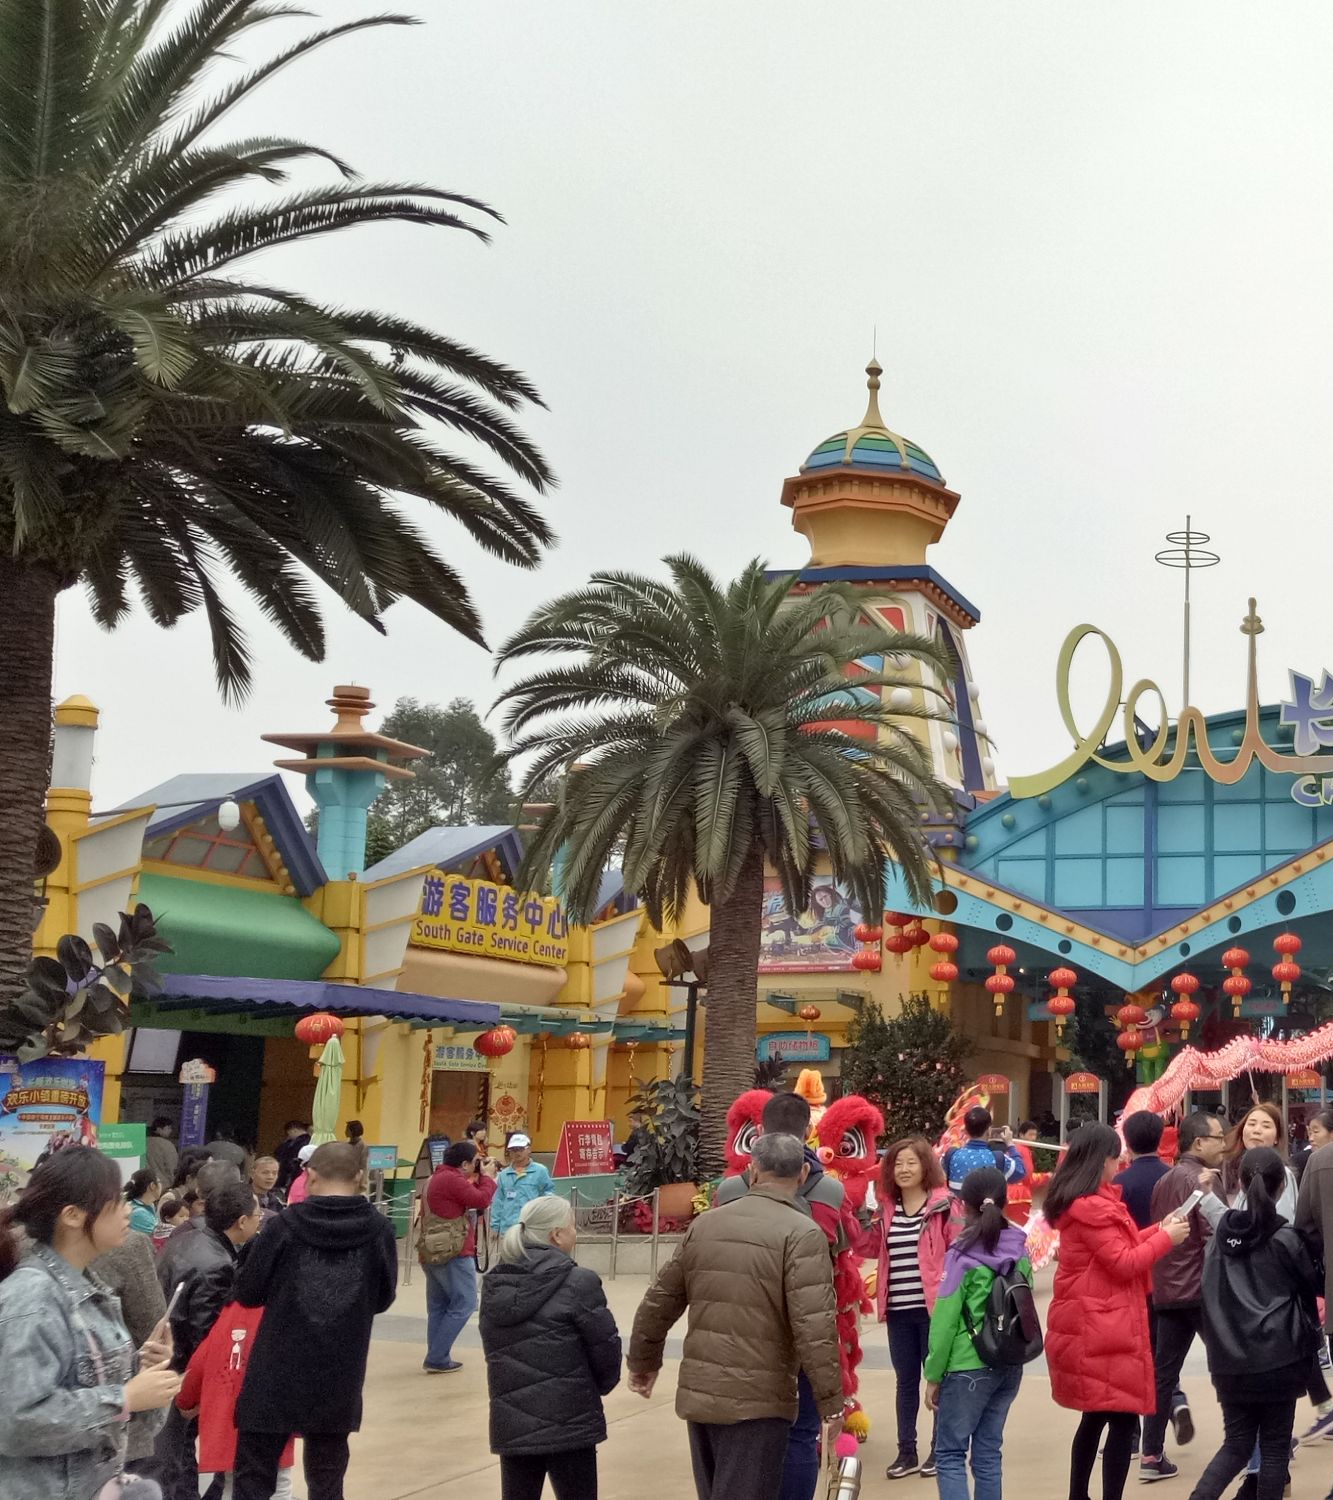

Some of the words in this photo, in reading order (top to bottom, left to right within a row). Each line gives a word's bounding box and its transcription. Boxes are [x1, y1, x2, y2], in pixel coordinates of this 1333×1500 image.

[421, 874, 569, 940] 游客服务中心
[416, 919, 451, 942] South
[456, 926, 484, 947] Gate
[490, 932, 529, 954] Service
[533, 939, 567, 960] Center
[435, 1045, 488, 1060] 游客服务中
